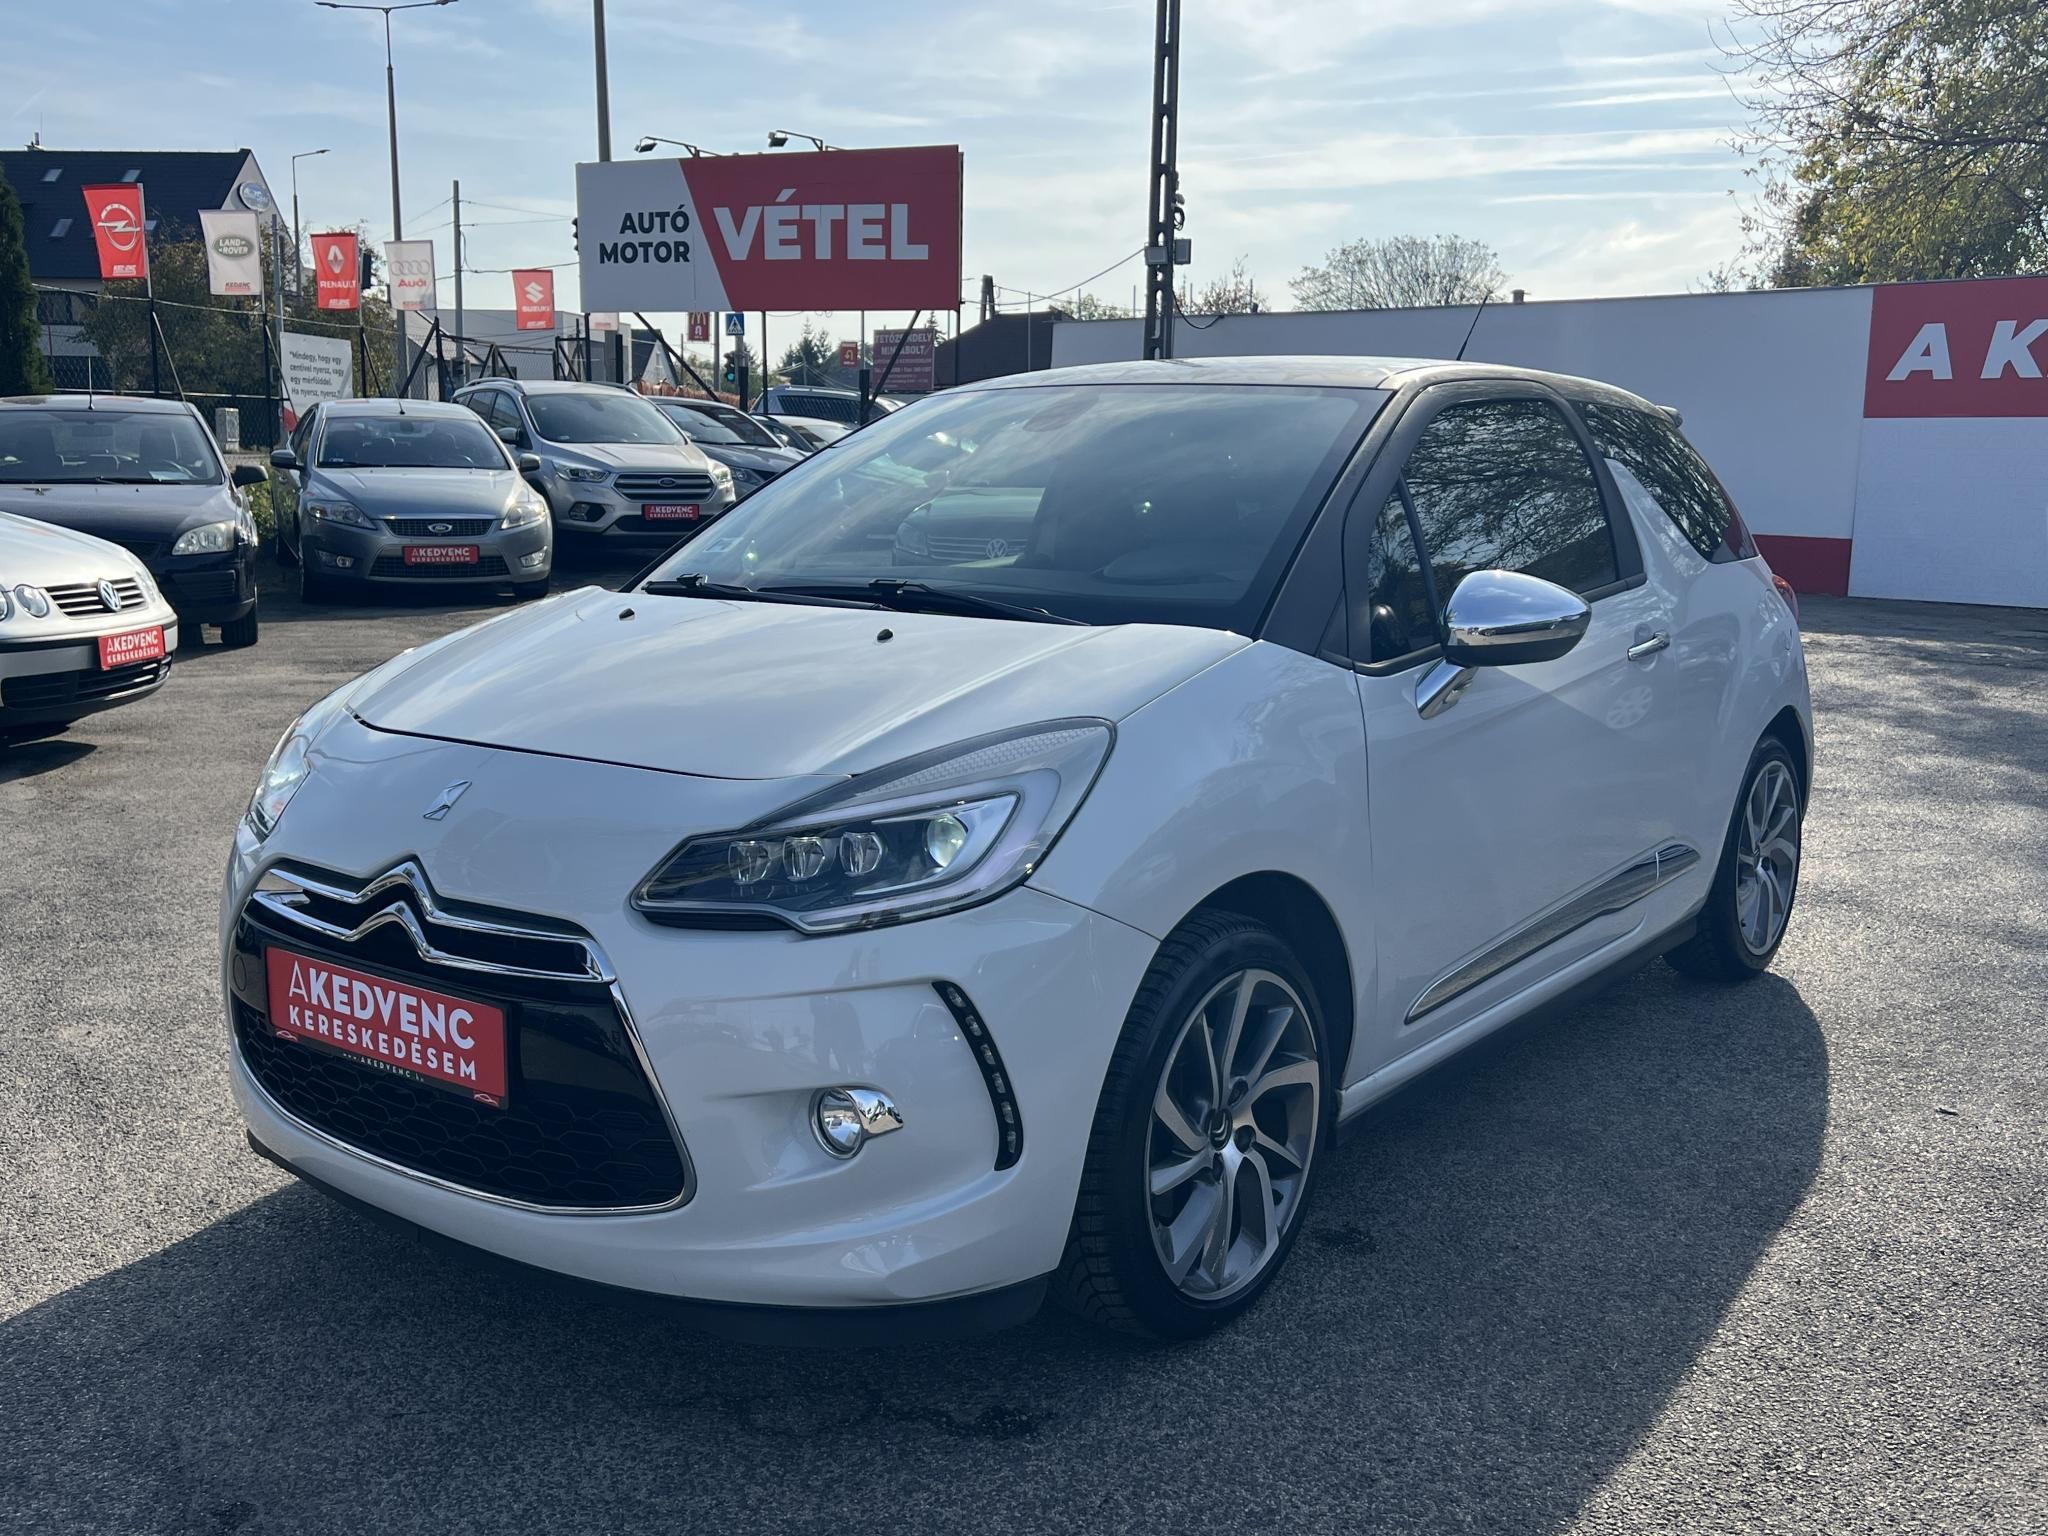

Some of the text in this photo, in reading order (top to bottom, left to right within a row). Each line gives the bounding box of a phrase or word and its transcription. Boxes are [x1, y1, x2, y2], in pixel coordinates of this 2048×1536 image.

[619, 204, 690, 234] AUTÓ
[712, 188, 929, 261] VÉTEL
[219, 238, 242, 247] LAND
[222, 245, 249, 254] ROVER
[599, 241, 690, 264] MOTOR
[319, 280, 357, 289] RENAULT
[521, 305, 550, 313] SUZUKI
[1980, 318, 2048, 379] K
[411, 547, 470, 557] AKEDVENC
[106, 630, 159, 653] AKEDVENC
[288, 959, 476, 1050] AKEDVENC
[289, 1004, 477, 1081] KERESKEDÉSEM
